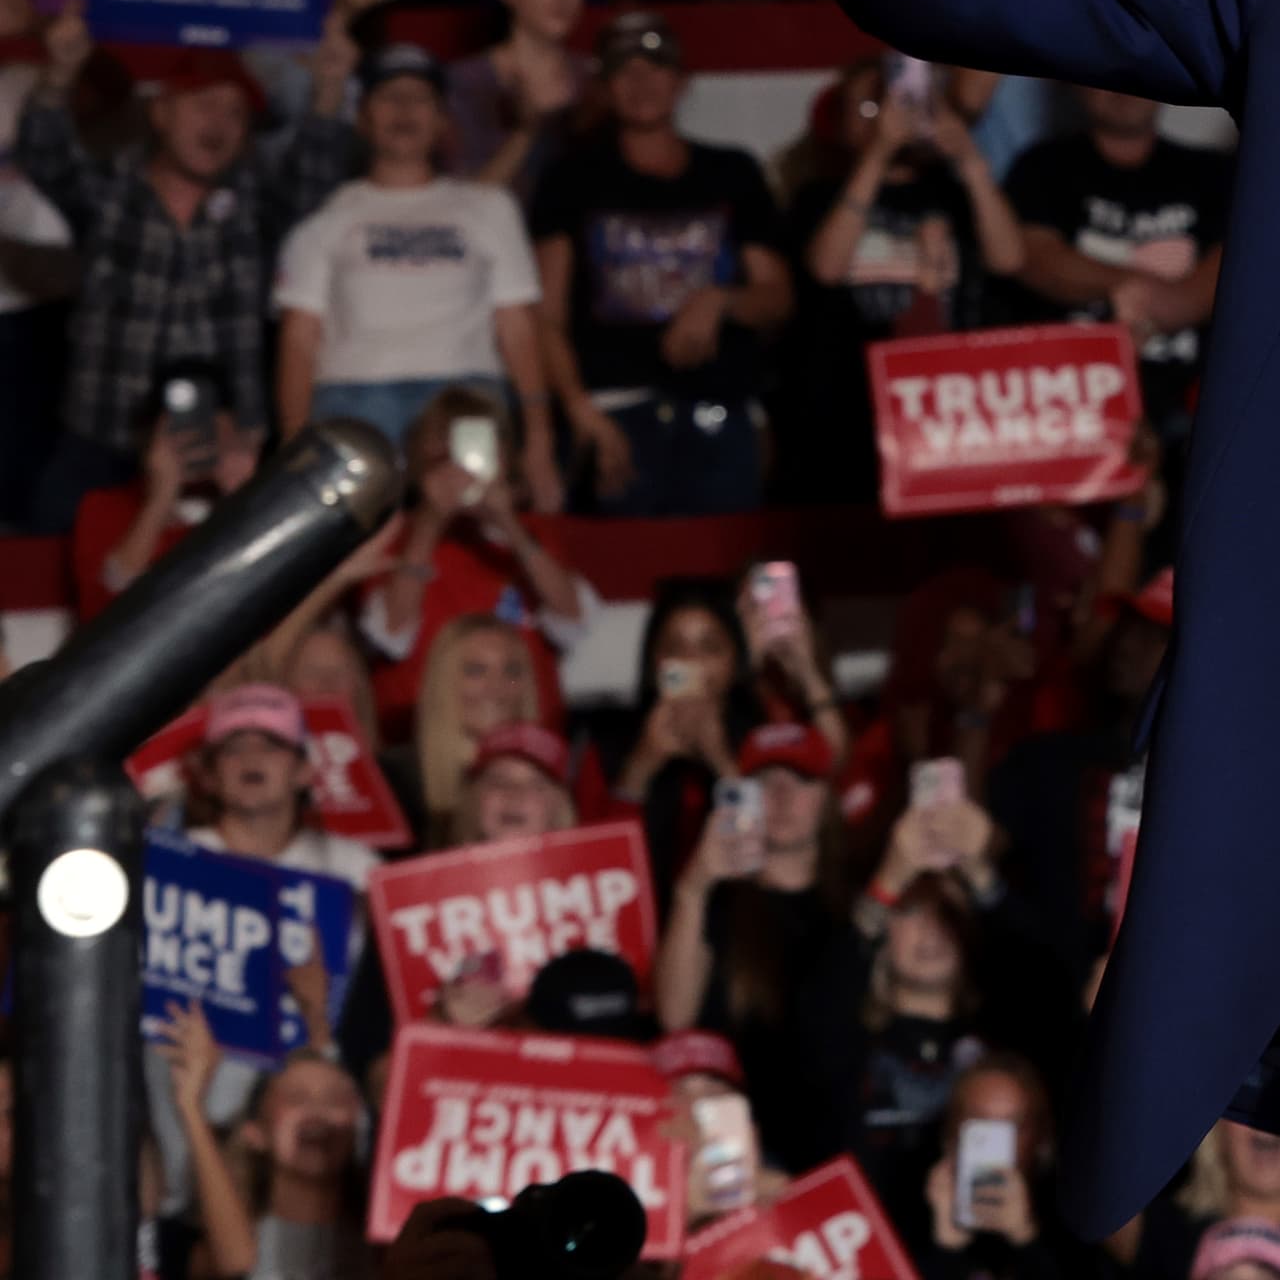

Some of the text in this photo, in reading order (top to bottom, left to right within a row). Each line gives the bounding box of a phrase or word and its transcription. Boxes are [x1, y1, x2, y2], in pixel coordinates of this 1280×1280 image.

[888, 362, 1127, 421] TRUMP
[920, 410, 1108, 453] VANCE
[143, 875, 272, 956] UMP
[391, 867, 638, 957] TRUMP
[427, 1096, 638, 1160] VANCE
